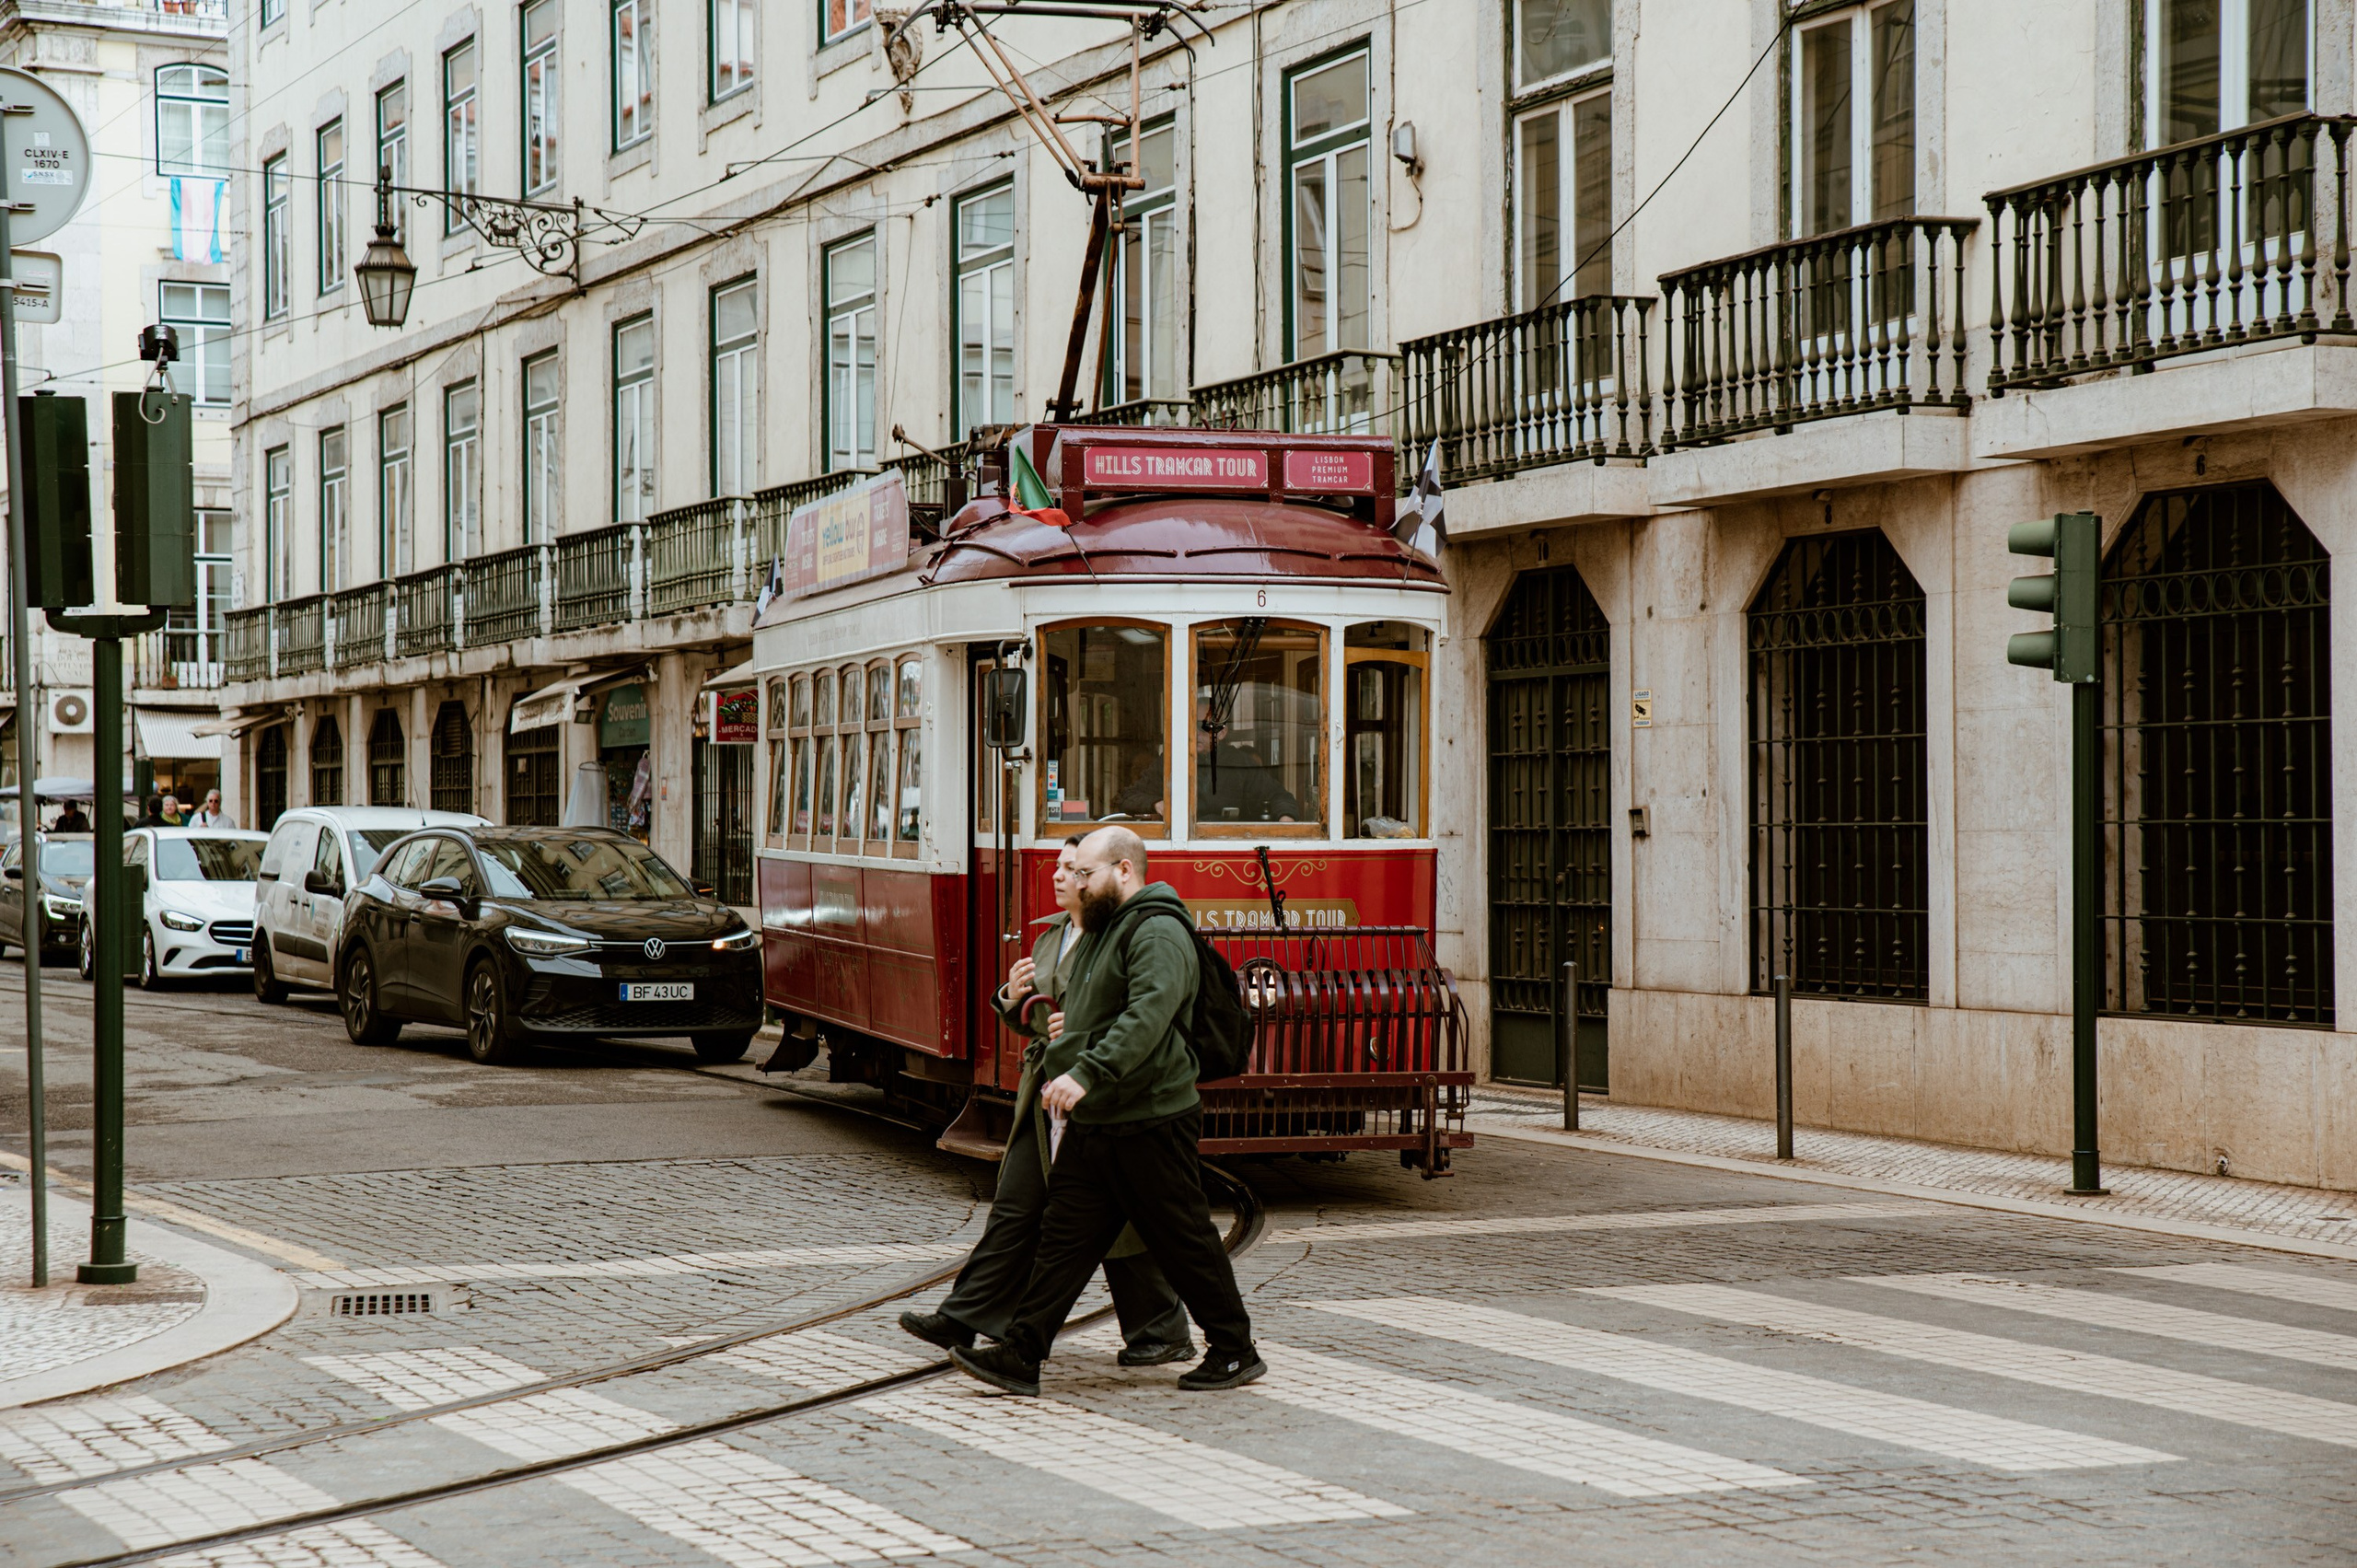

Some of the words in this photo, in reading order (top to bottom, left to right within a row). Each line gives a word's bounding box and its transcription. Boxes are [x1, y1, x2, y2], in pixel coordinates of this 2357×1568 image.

[24, 148, 69, 159] CLXIV-E
[34, 159, 60, 168] 1670
[1095, 455, 1142, 475] HILLS
[1145, 456, 1213, 476] TRAMCAR
[1216, 458, 1257, 477] TOUR
[2196, 454, 2205, 476] 6
[1312, 475, 1348, 483] TRAMCAR
[1258, 589, 1266, 608] 6
[608, 697, 647, 722] Souvenir
[721, 725, 758, 734] MERCAD
[1306, 909, 1346, 928] TOUR
